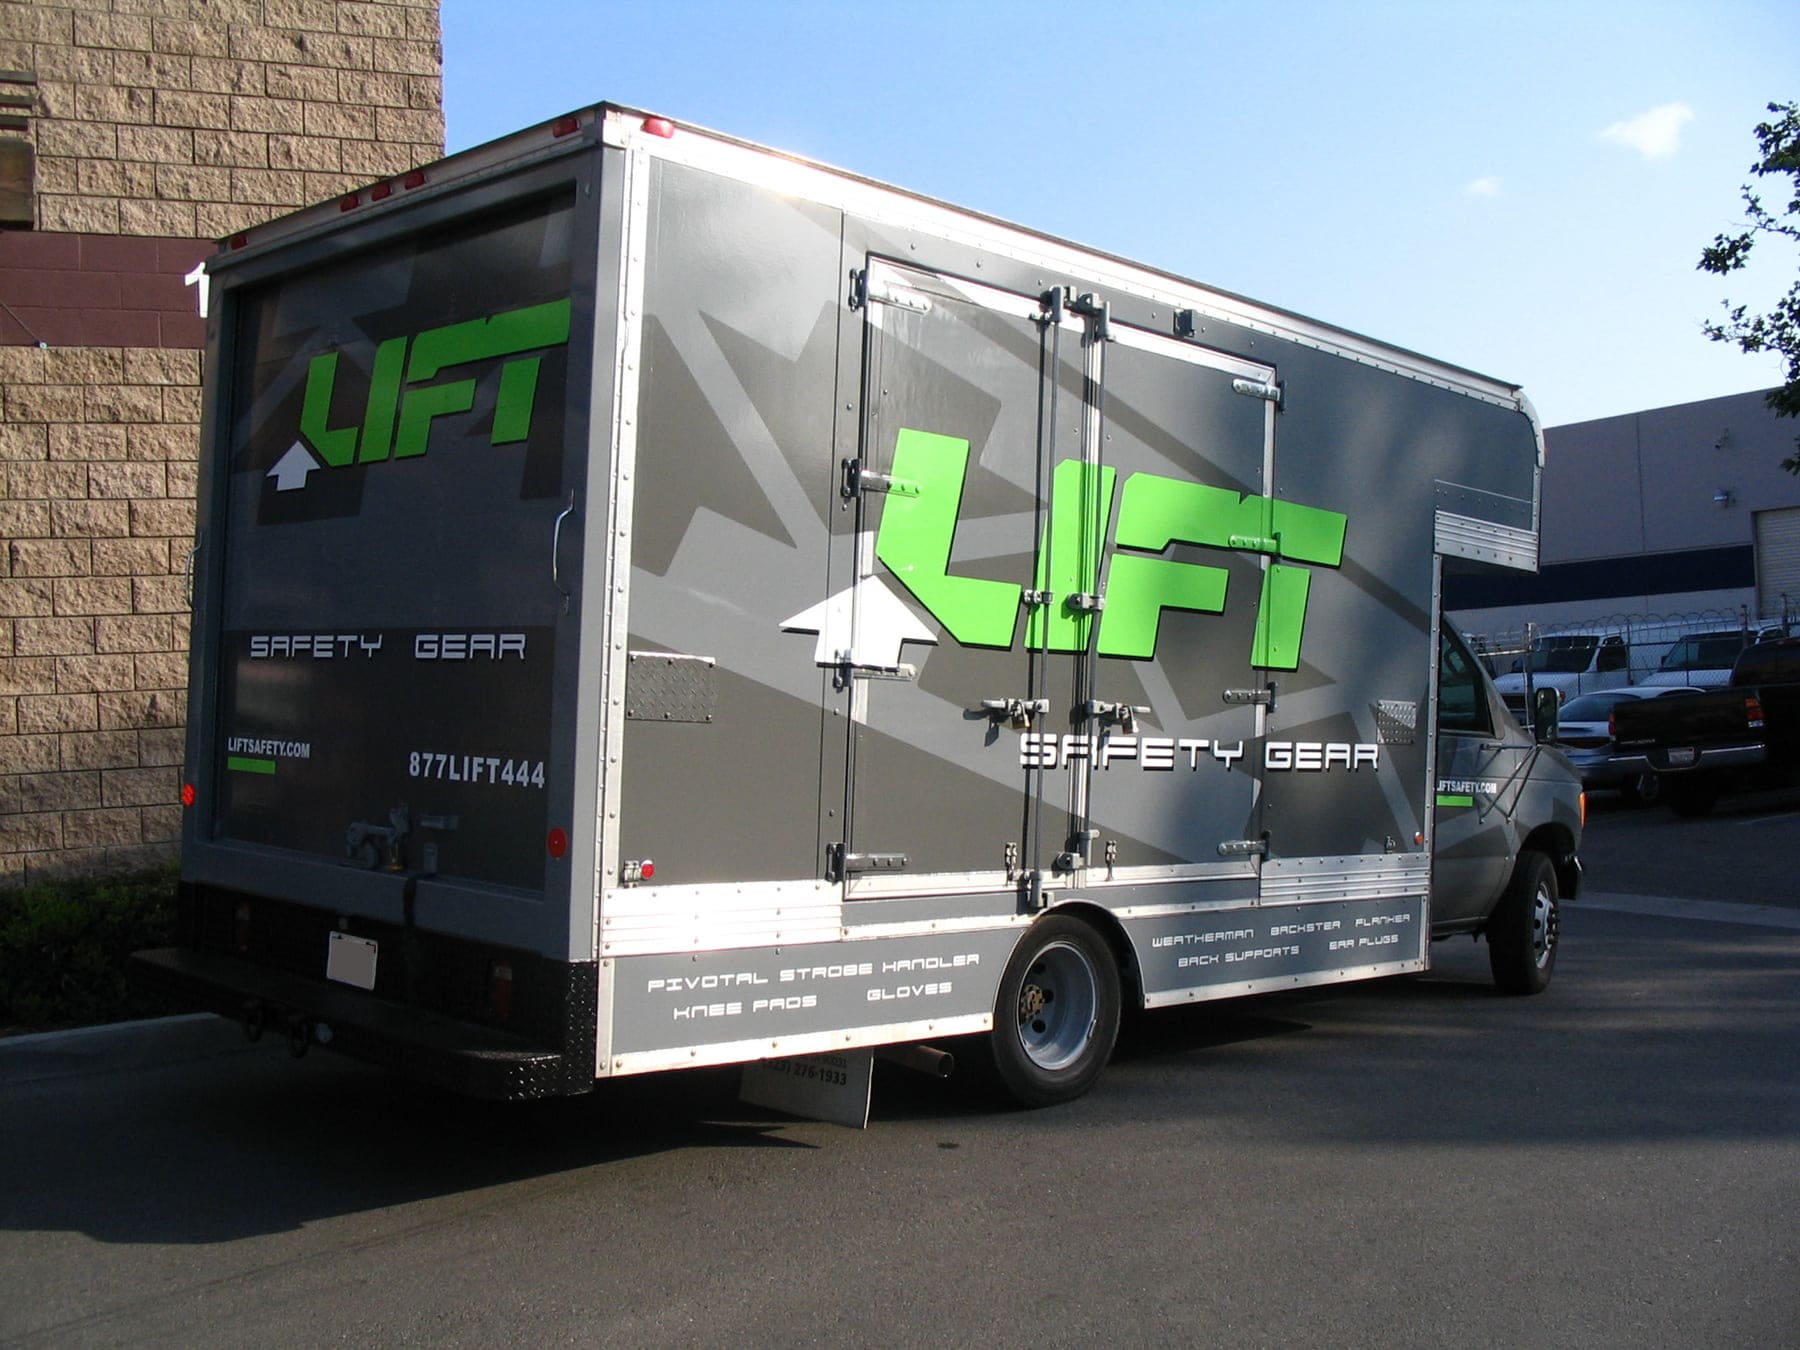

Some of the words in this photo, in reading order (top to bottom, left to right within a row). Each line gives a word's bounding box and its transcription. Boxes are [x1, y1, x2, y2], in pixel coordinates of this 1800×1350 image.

[299, 298, 571, 466] LIFT
[875, 428, 1348, 670] LIFT
[249, 633, 383, 660] SAFETY
[414, 632, 527, 662] GEAR
[228, 736, 311, 759] LIFTSAFETY.COM
[1019, 732, 1244, 770] SAFETY
[1264, 740, 1380, 771] GEAR
[408, 751, 546, 790] 877LIFT444
[1152, 929, 1254, 948] WEATHERMAN
[1270, 920, 1342, 936] BACKSTER
[1329, 940, 1355, 951] EAR
[1358, 934, 1399, 949] PLUGS
[1178, 955, 1220, 968] BACK
[1225, 945, 1300, 963] SUPPORTS
[647, 972, 769, 993] PIVOTAL
[779, 963, 873, 982] STROBE
[882, 953, 980, 973] HANDLER
[867, 981, 952, 1001] GLOVES
[673, 1002, 742, 1020] KNEE
[752, 995, 817, 1012] PADS
[793, 1062, 847, 1086] 276-1933
